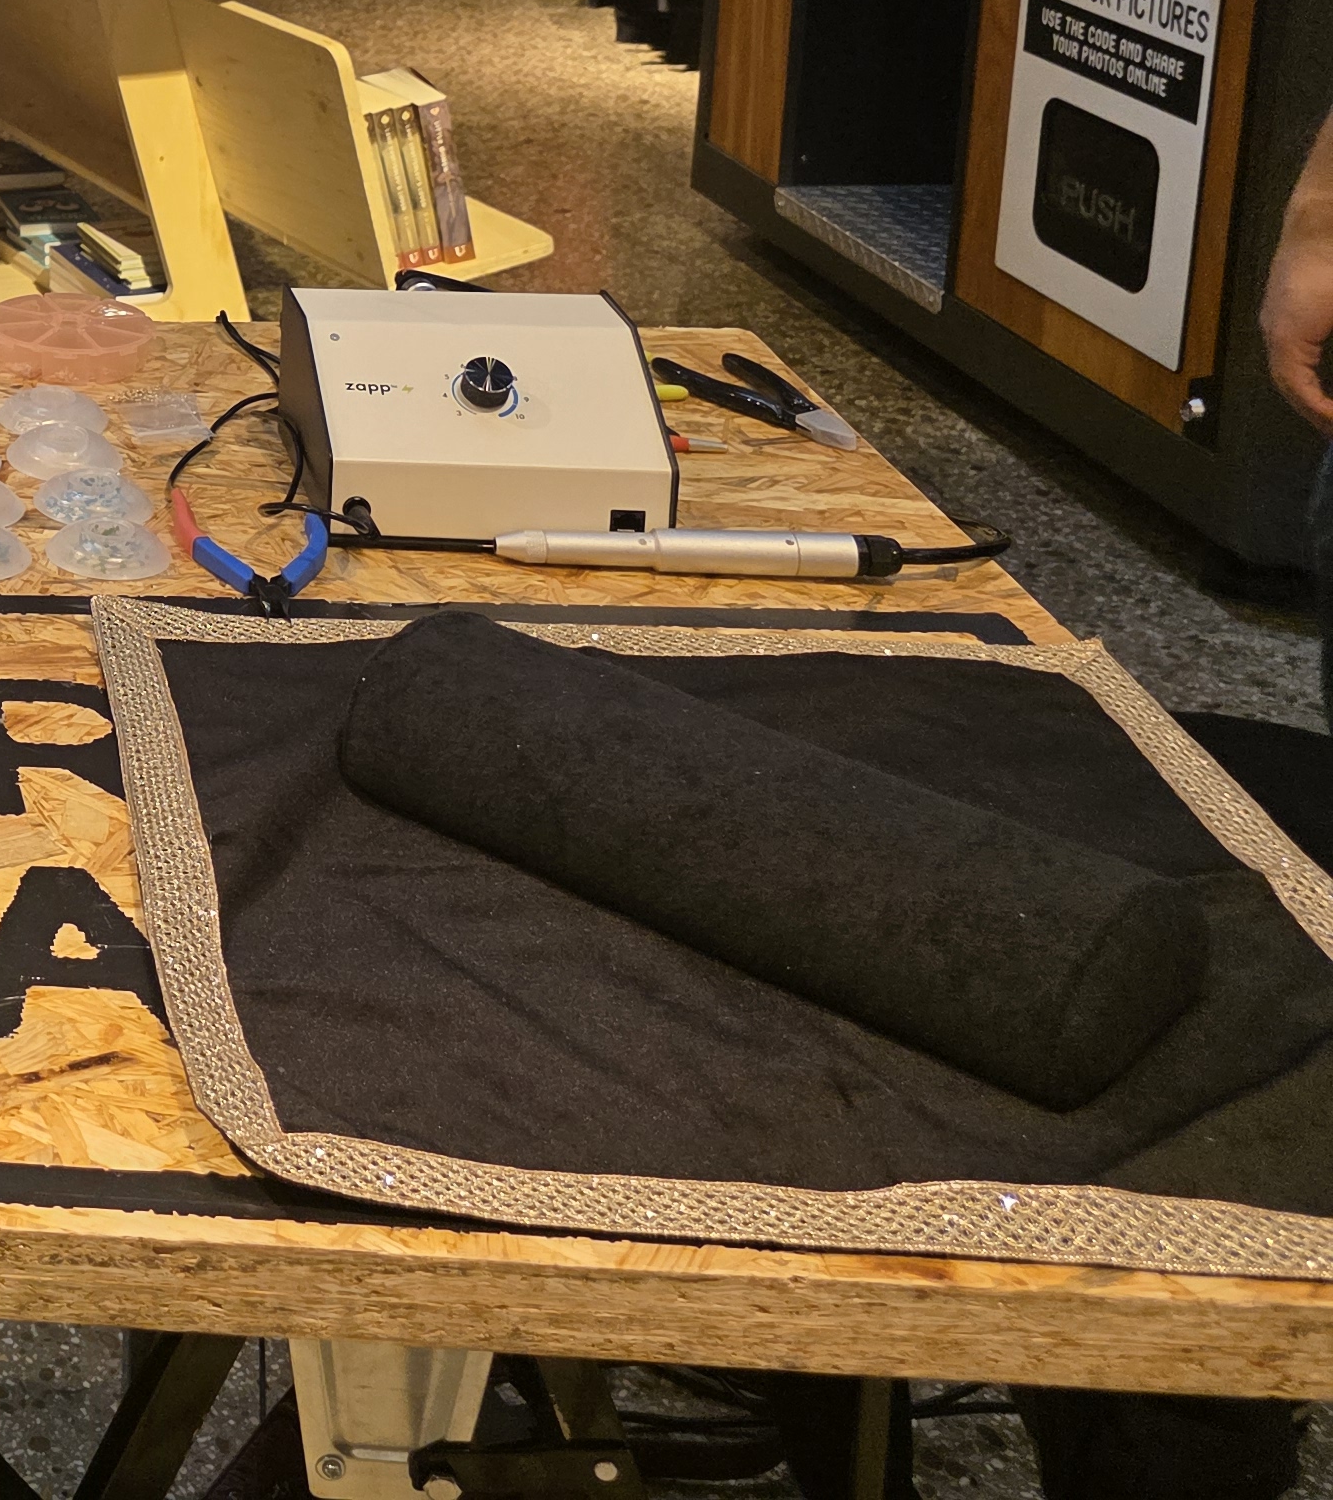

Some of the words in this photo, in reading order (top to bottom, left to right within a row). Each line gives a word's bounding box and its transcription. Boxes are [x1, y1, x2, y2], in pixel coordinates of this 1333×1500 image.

[1041, 6, 1063, 31] USE
[1065, 16, 1086, 40] THE
[1087, 25, 1117, 53] CODE
[1119, 38, 1144, 63] AND
[1144, 48, 1184, 81] SHARE
[1052, 33, 1079, 60] YOUR
[1080, 46, 1126, 79] PHOTOS
[1127, 65, 1167, 98] ONLINE
